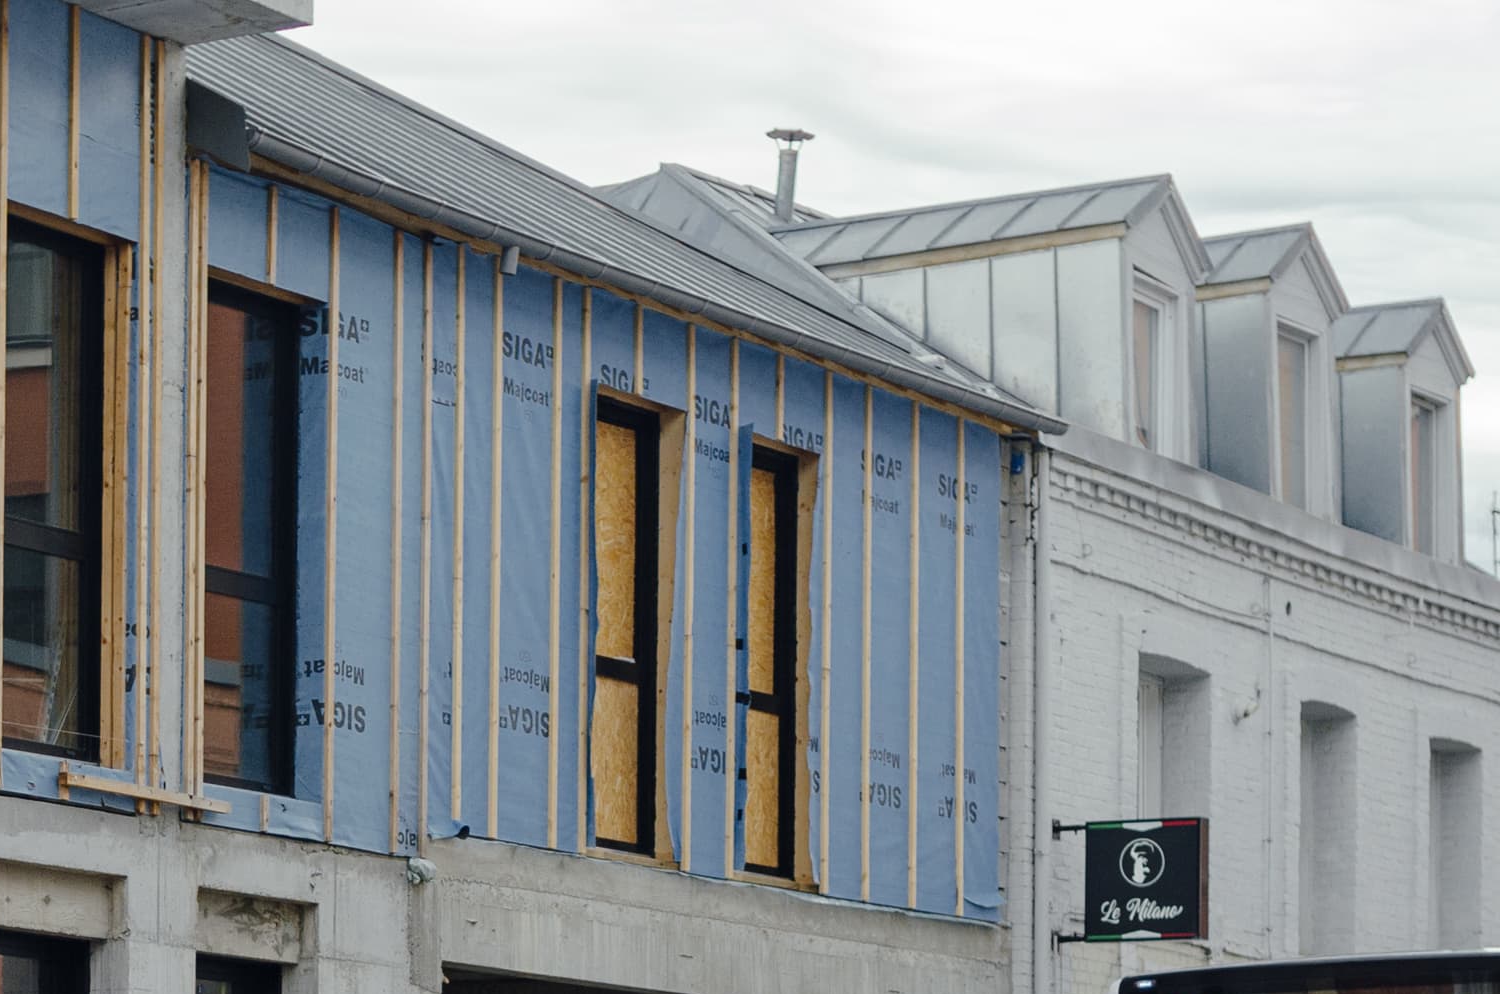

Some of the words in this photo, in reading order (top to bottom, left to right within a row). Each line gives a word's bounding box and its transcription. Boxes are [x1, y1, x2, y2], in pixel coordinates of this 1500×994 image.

[502, 331, 545, 369] SIGA
[301, 357, 364, 384] Macoat
[503, 376, 549, 407] Majcoat
[862, 490, 899, 515] ajcoat
[304, 659, 364, 686] Majcat
[504, 666, 549, 693] Majcoat
[508, 704, 549, 738] SIGA
[695, 710, 727, 731] ajcoat
[699, 747, 726, 775] IGA
[945, 796, 978, 824] SIA
[1100, 899, 1121, 924] Le
[1125, 898, 1183, 922] Milano
